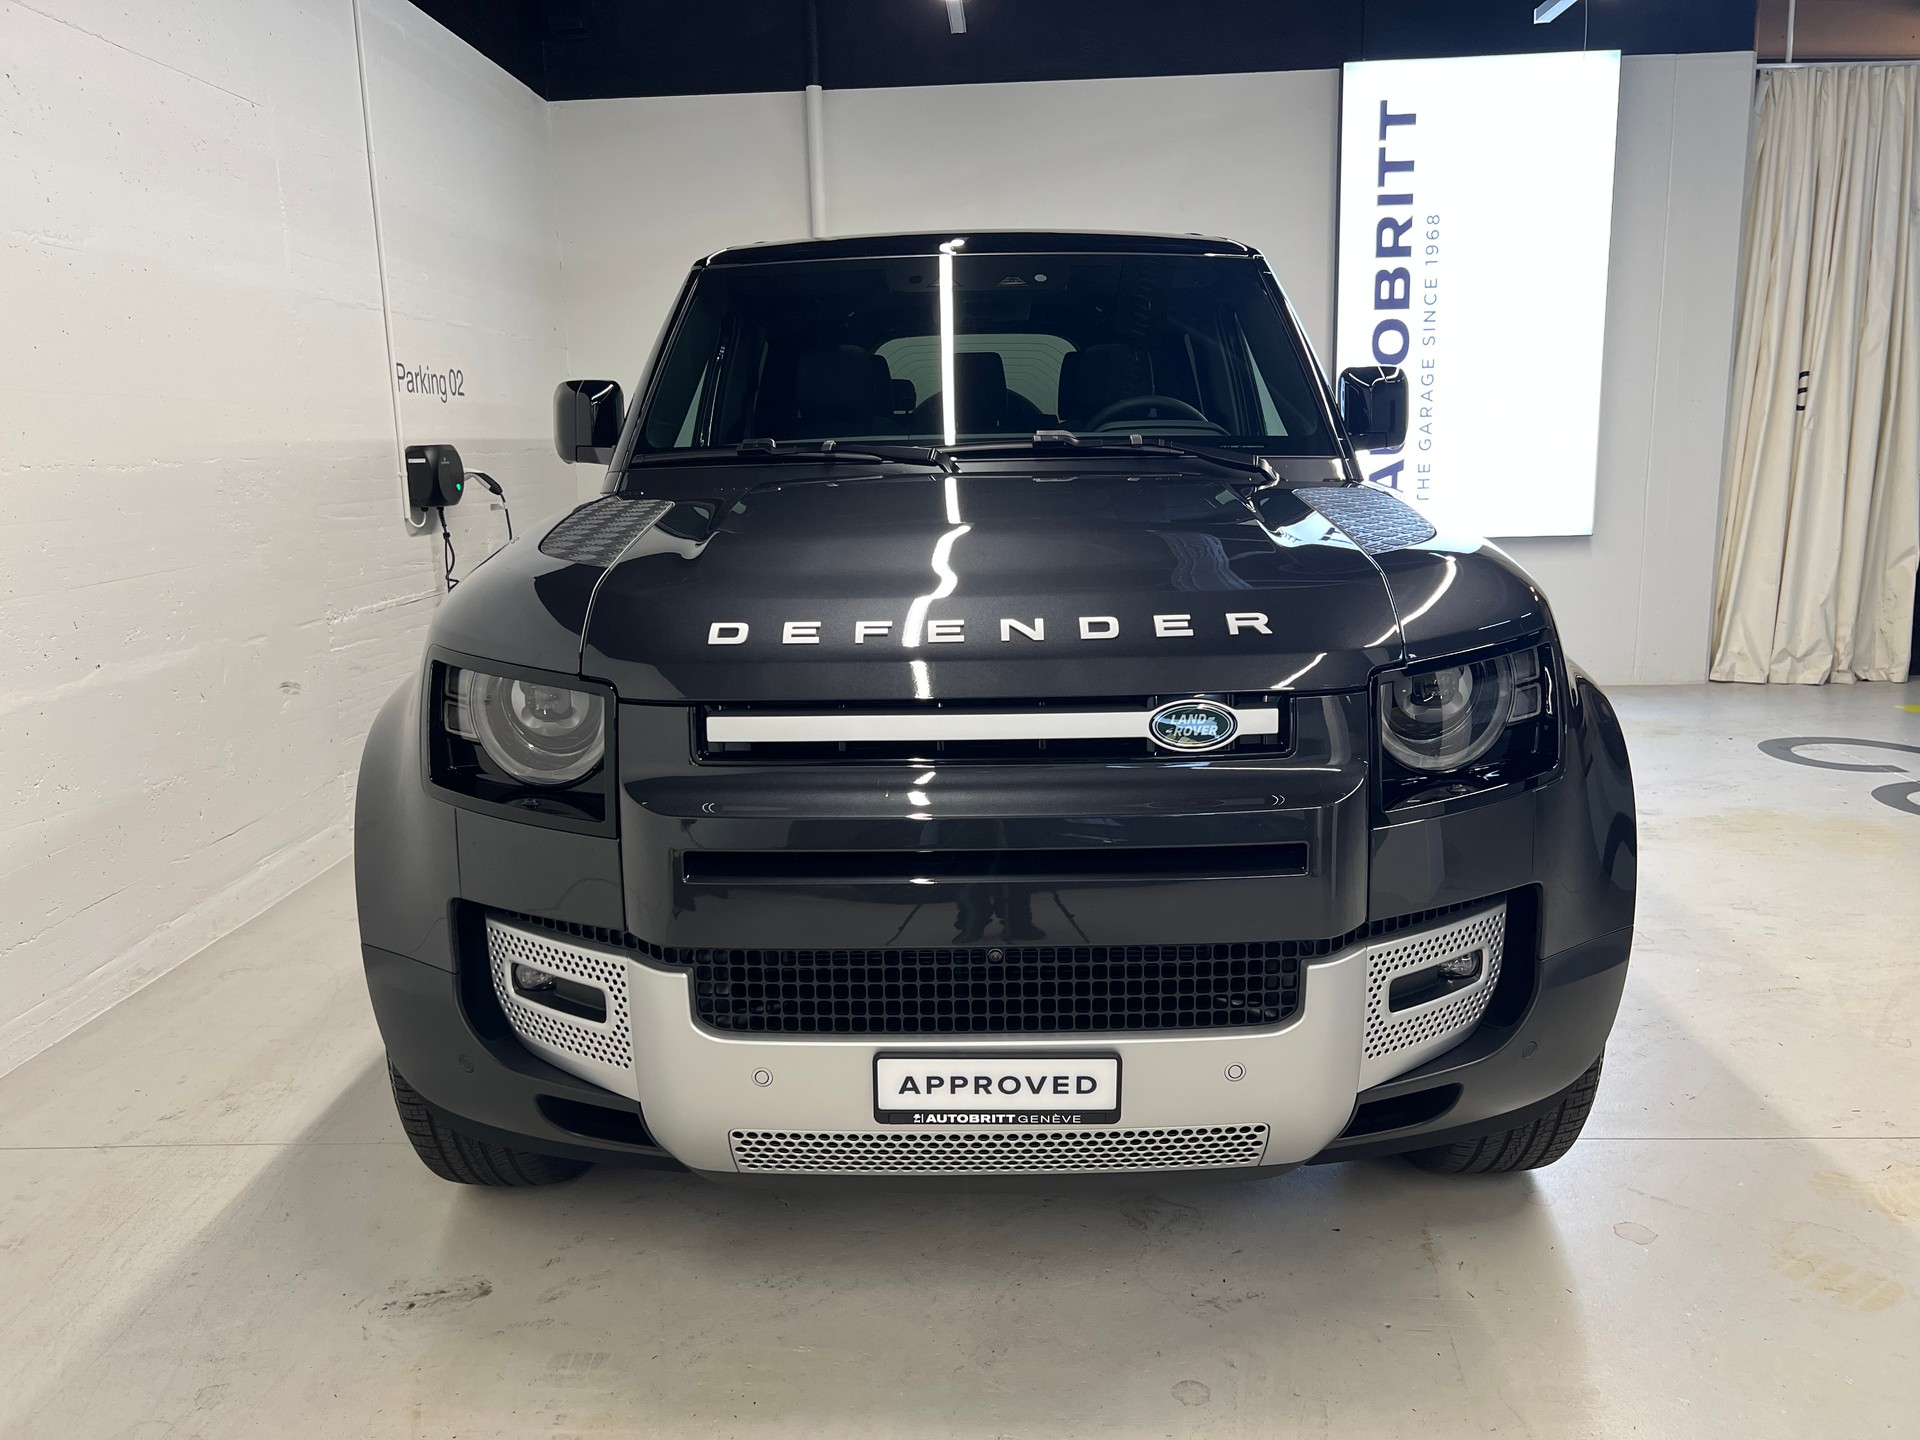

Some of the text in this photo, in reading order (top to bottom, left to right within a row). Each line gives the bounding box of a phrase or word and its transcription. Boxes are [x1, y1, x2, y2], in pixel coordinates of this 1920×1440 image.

[1369, 100, 1416, 493] AOBRITT
[1416, 215, 1440, 501] THE GARAGE SINCE 1968
[396, 362, 465, 404] Parking 02
[707, 612, 1273, 645] DEFENDER
[1170, 713, 1207, 725] LAND
[1173, 725, 1219, 737] ROVER
[898, 1075, 1098, 1095] APPROVED
[925, 1112, 1082, 1124] AUTOBRITT GENÈVE
